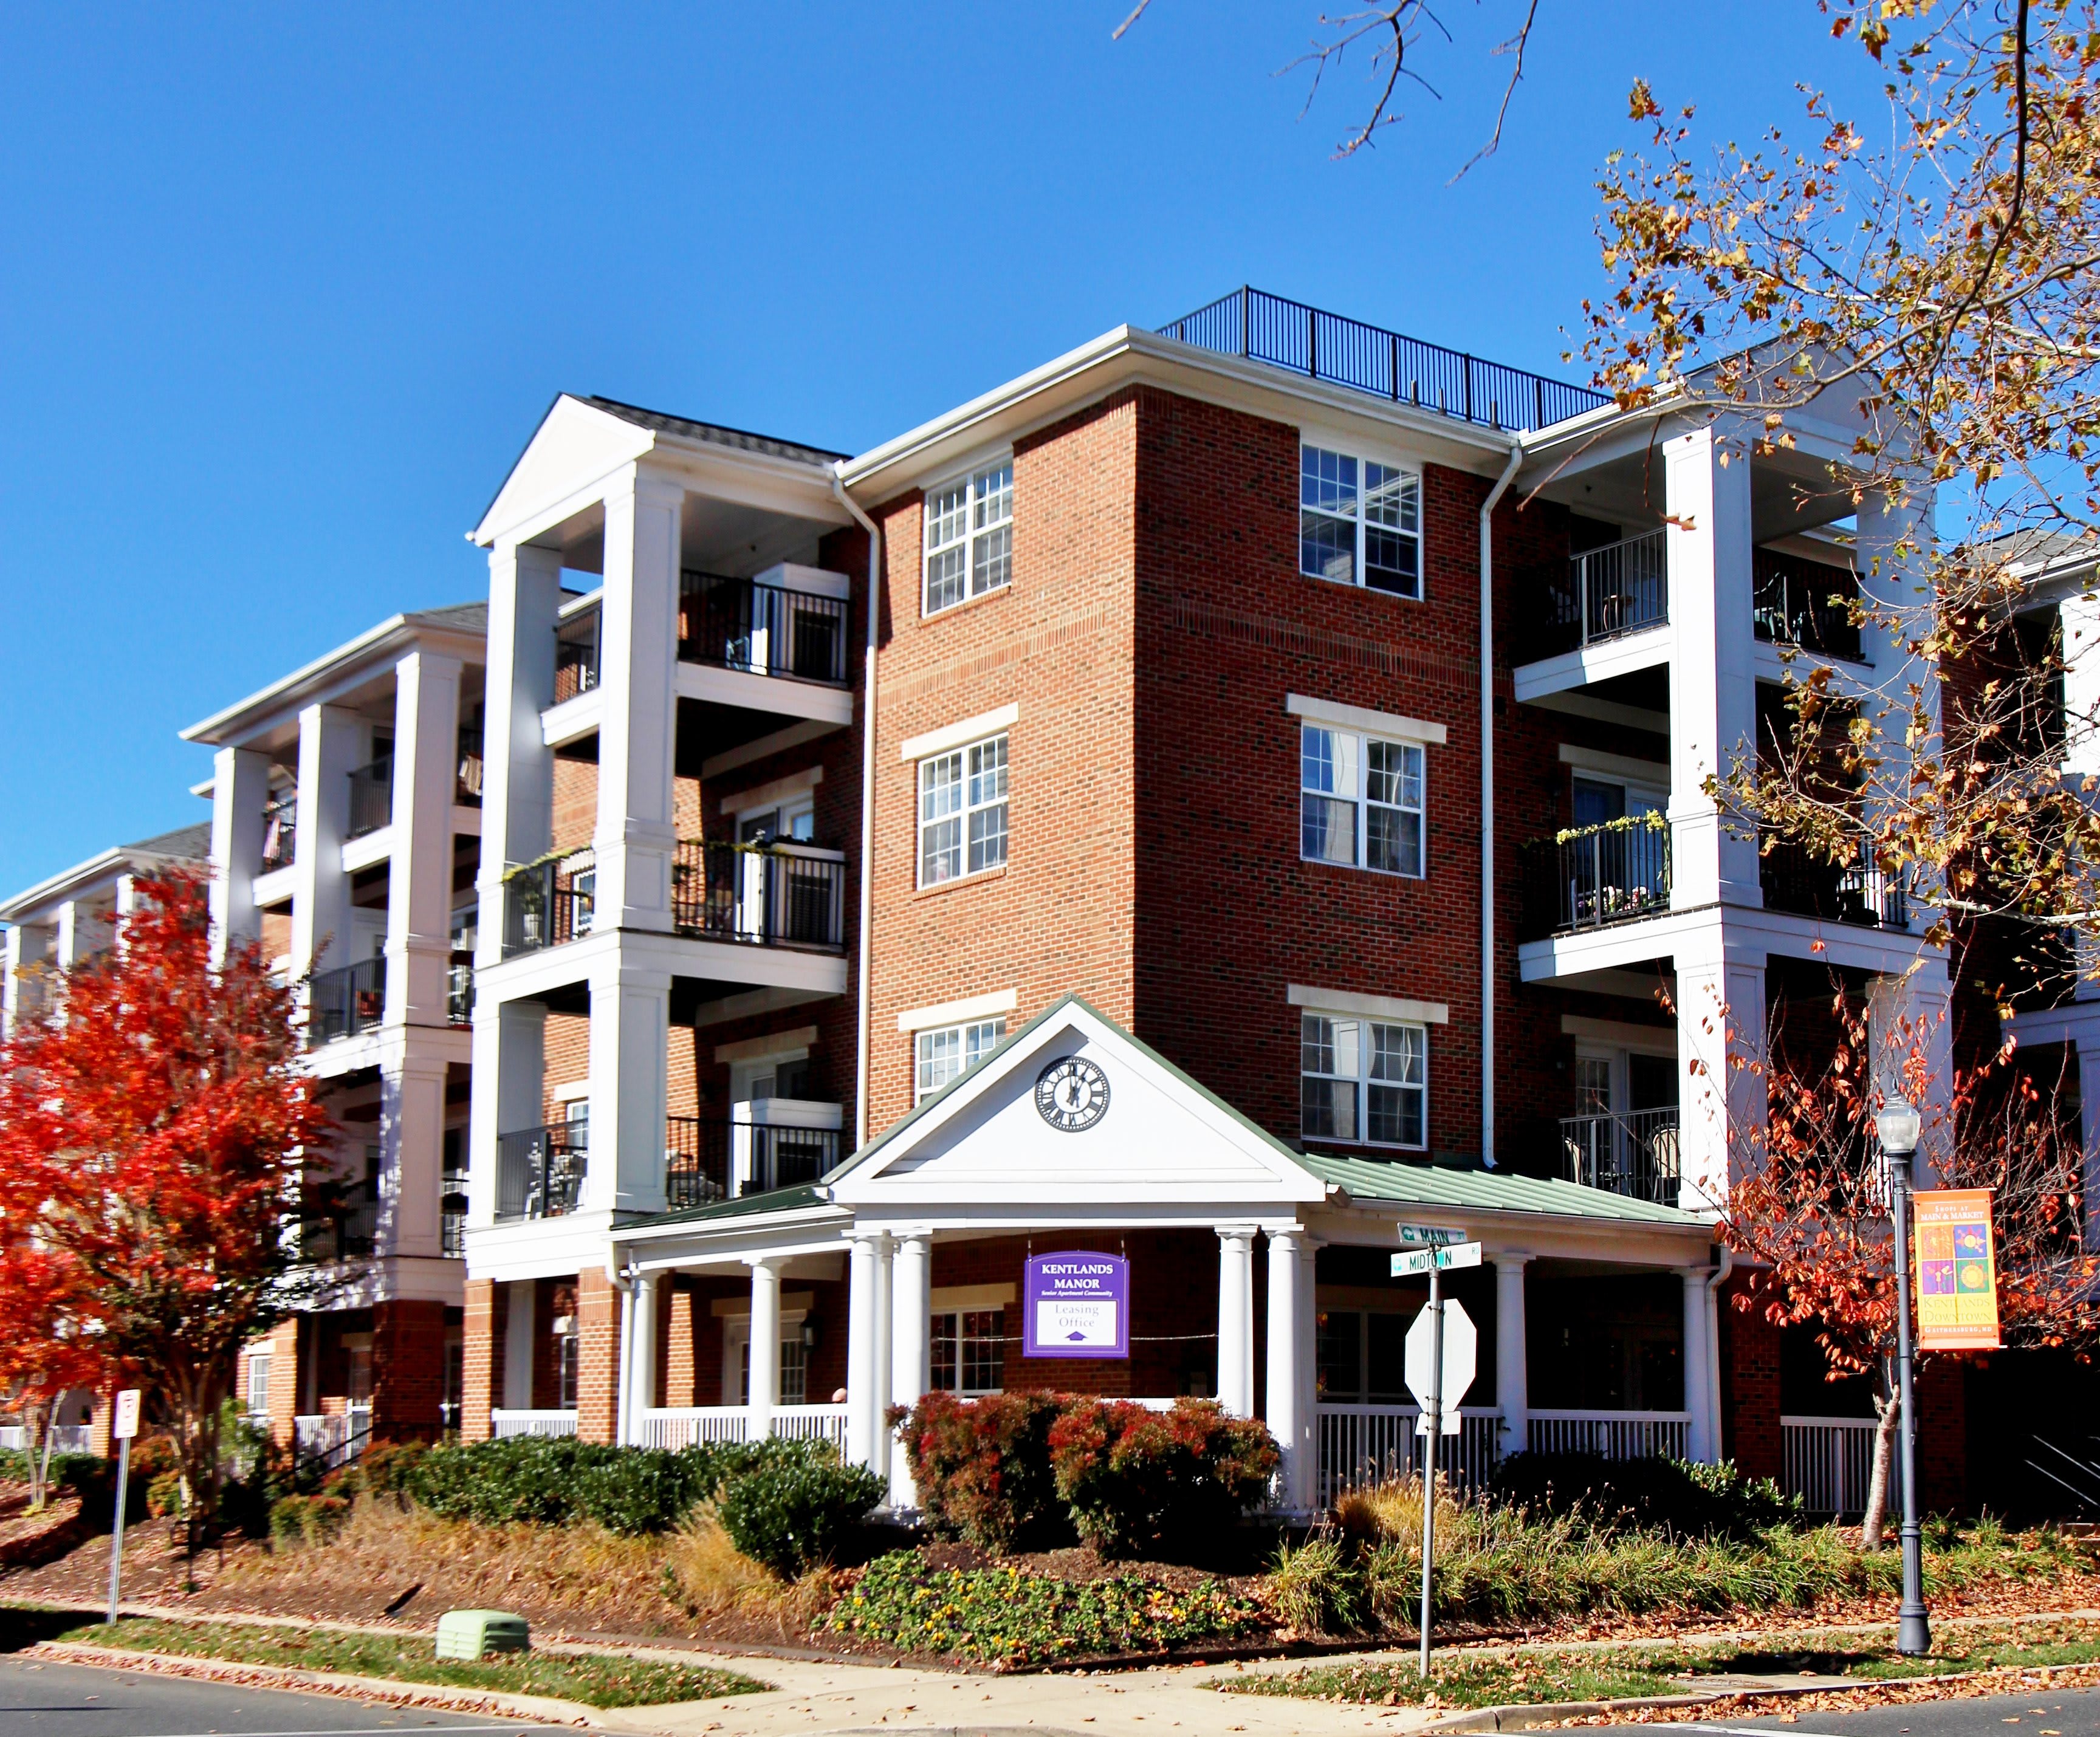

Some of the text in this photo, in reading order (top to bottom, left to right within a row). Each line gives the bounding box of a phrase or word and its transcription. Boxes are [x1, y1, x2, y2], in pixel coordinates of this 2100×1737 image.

[1951, 1211, 1984, 1220] MARKET
[1419, 1228, 1450, 1244] MAIN
[1457, 1231, 1464, 1239] ST
[1409, 1250, 1452, 1271] MIDTOWN
[1472, 1246, 1480, 1255] RD
[1041, 1264, 1113, 1274] KENTLANDS
[1054, 1278, 1100, 1289] MANOR
[1924, 1297, 1990, 1308] KENTLANDS
[1055, 1304, 1099, 1317] Leasing
[1924, 1310, 1991, 1322] DOWNTOWN
[1059, 1317, 1094, 1327] Office
